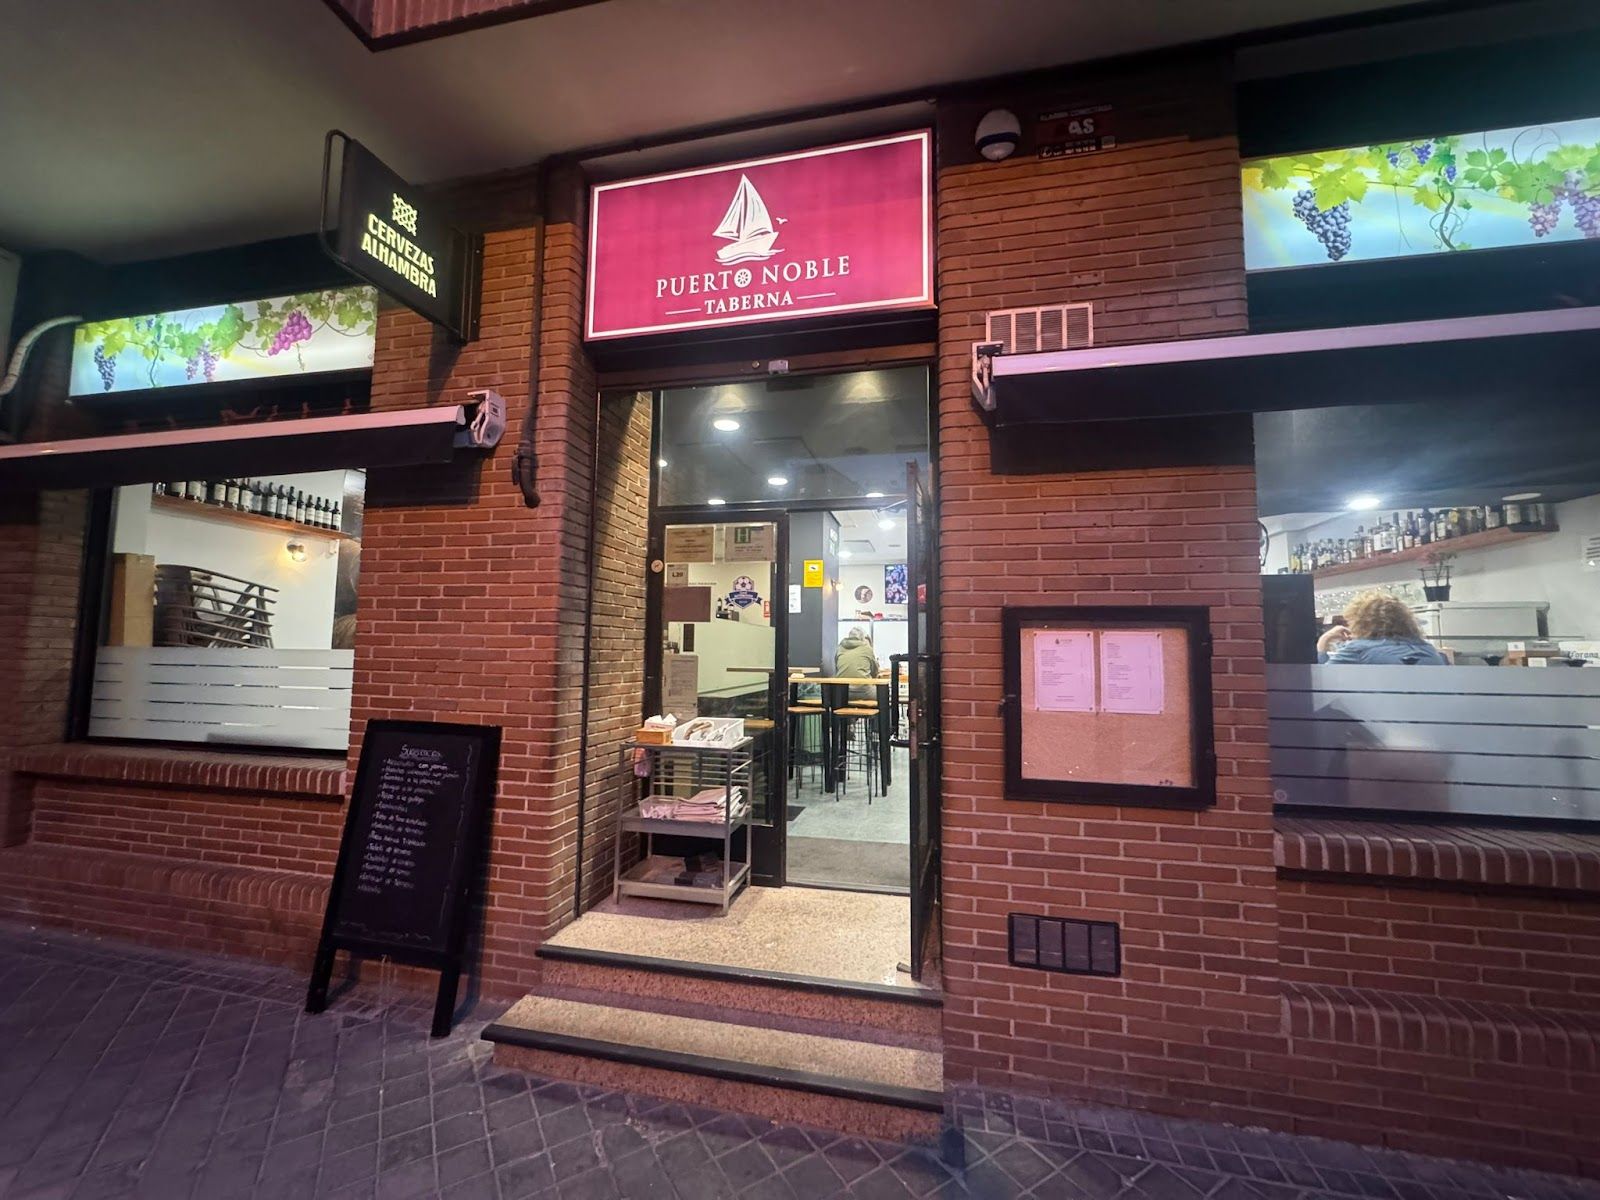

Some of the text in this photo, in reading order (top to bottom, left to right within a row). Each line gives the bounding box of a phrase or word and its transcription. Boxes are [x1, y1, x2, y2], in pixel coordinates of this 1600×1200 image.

[361, 232, 437, 298] ALHAMBRA
[367, 213, 434, 275] CERVEZAS
[656, 255, 850, 298] PUERTO NOBLE
[704, 290, 794, 315] TABERNA
